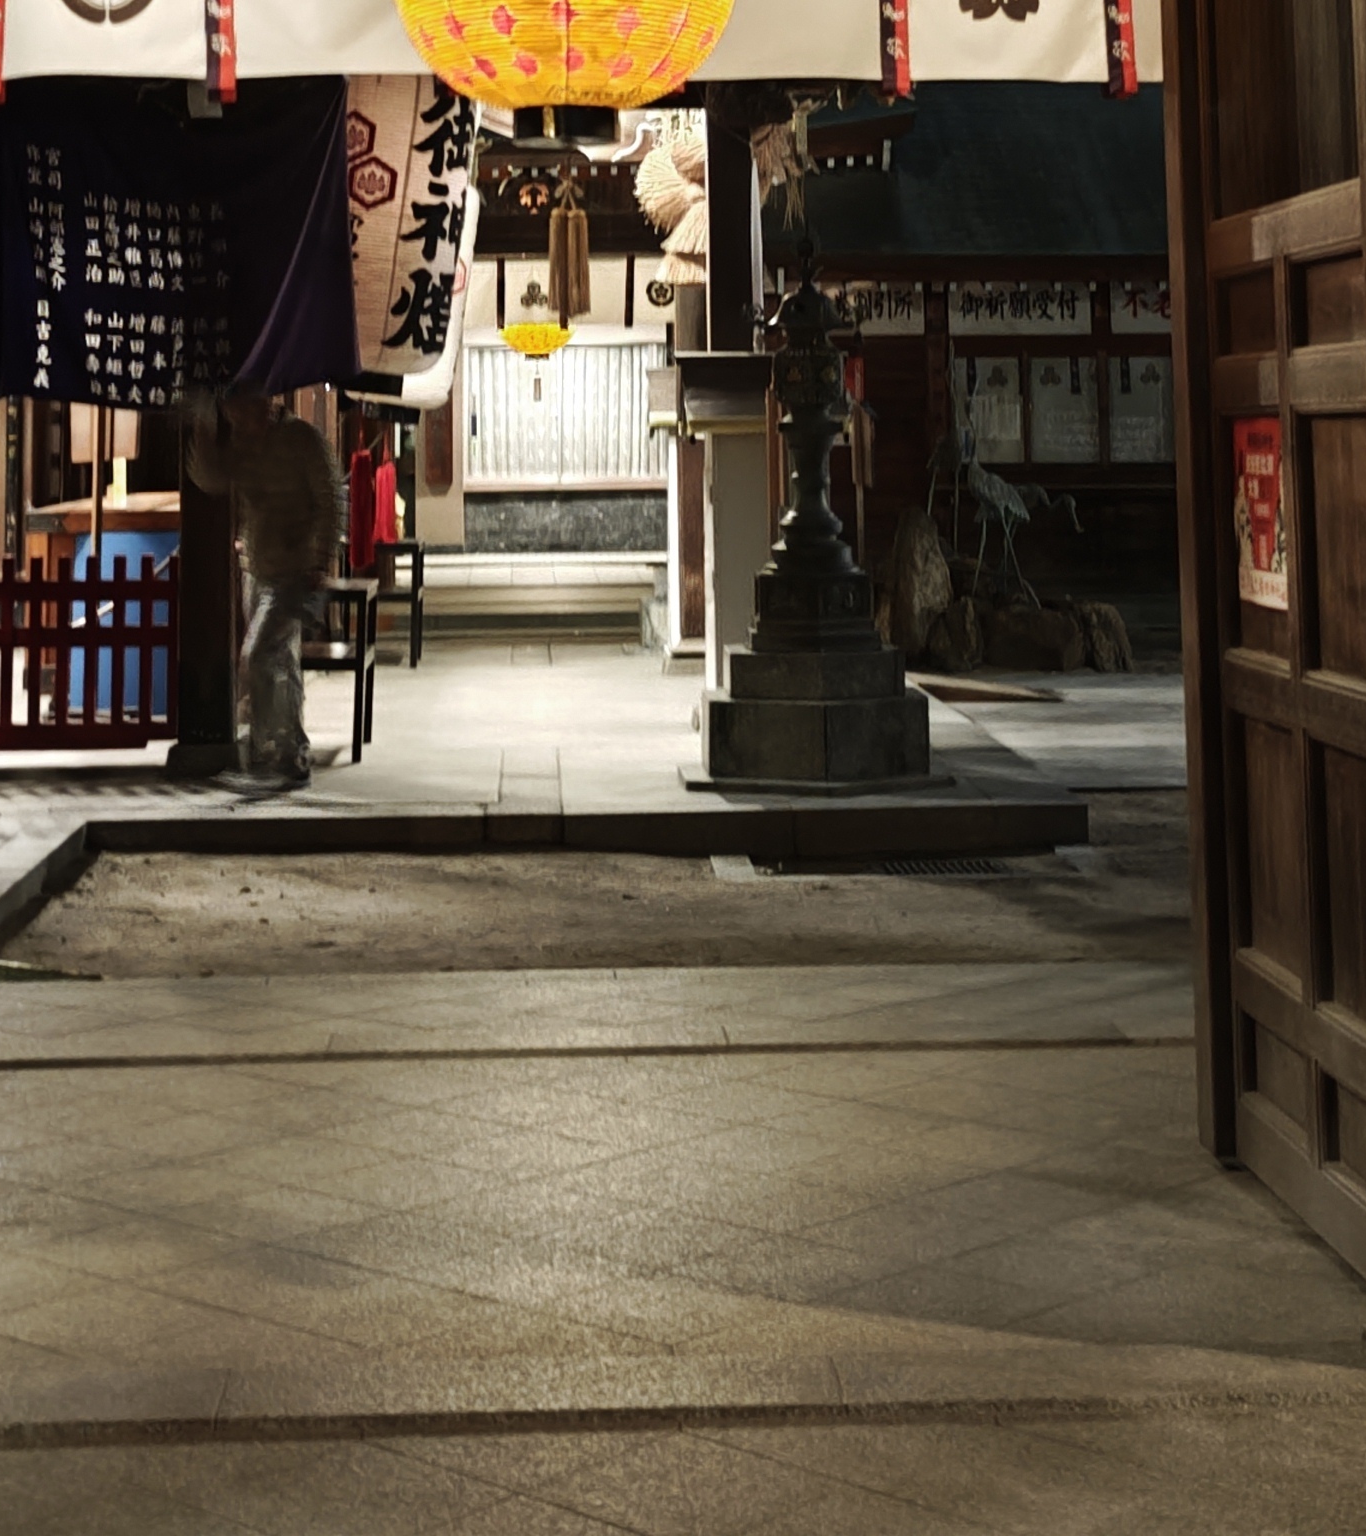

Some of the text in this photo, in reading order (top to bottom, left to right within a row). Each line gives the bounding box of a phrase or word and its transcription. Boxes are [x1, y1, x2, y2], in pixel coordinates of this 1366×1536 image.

[958, 289, 1080, 322] 御祈願受付
